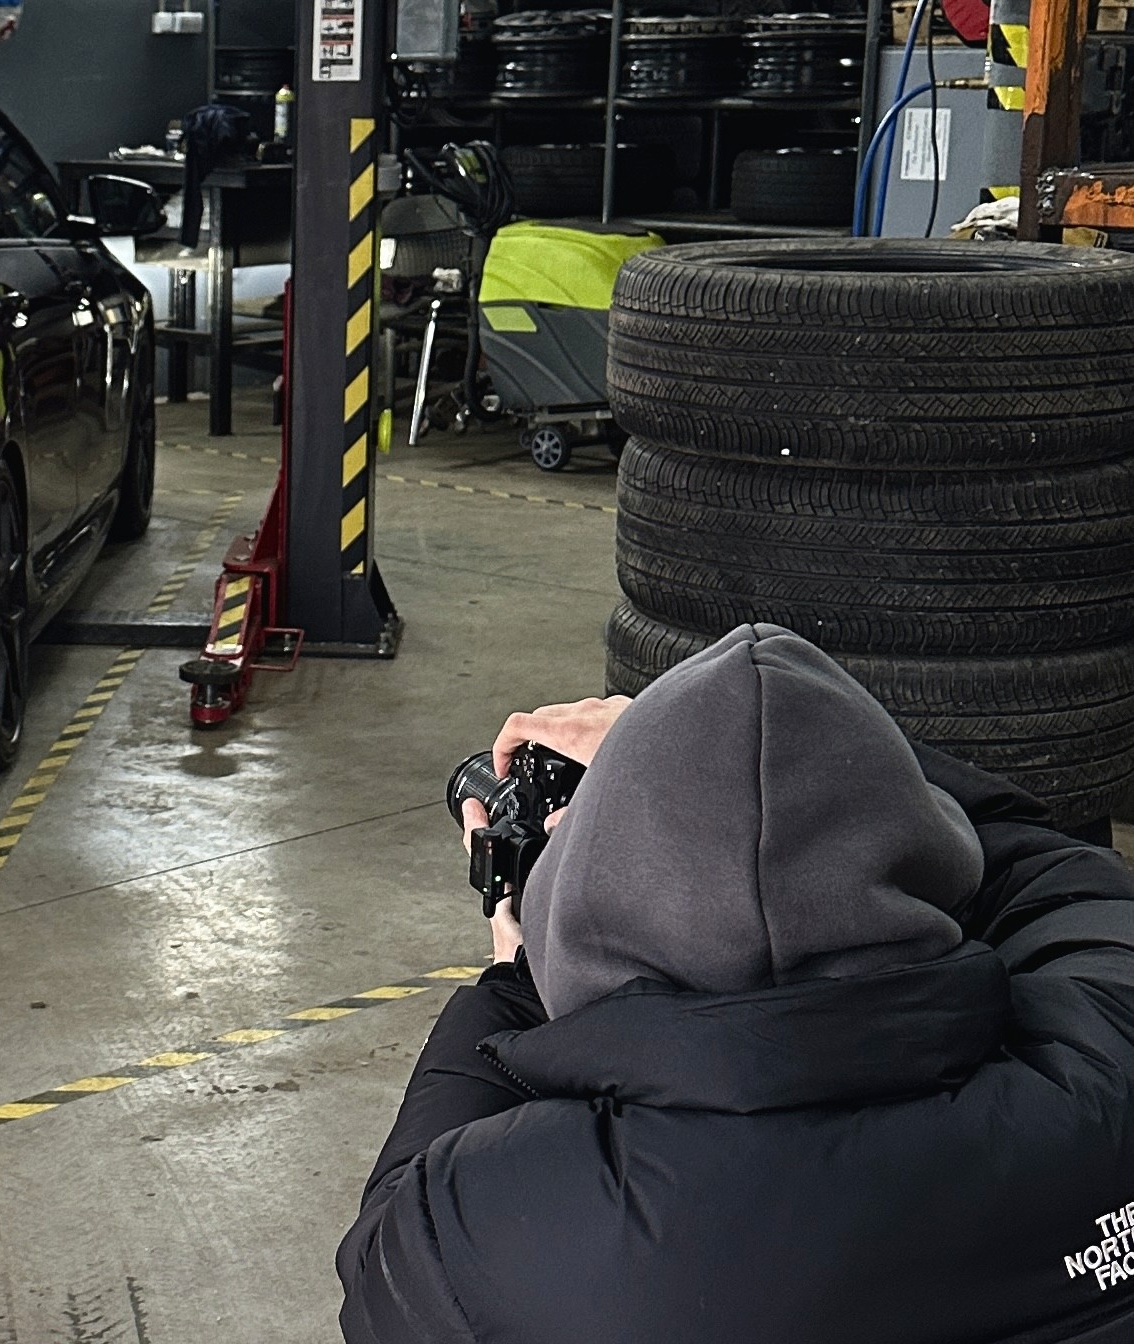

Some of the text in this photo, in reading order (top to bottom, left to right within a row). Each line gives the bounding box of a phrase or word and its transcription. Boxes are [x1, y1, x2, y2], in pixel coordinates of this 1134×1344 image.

[1095, 1201, 1134, 1238] THE
[1064, 1226, 1134, 1279] NORT
[1095, 1251, 1134, 1291] FAC
